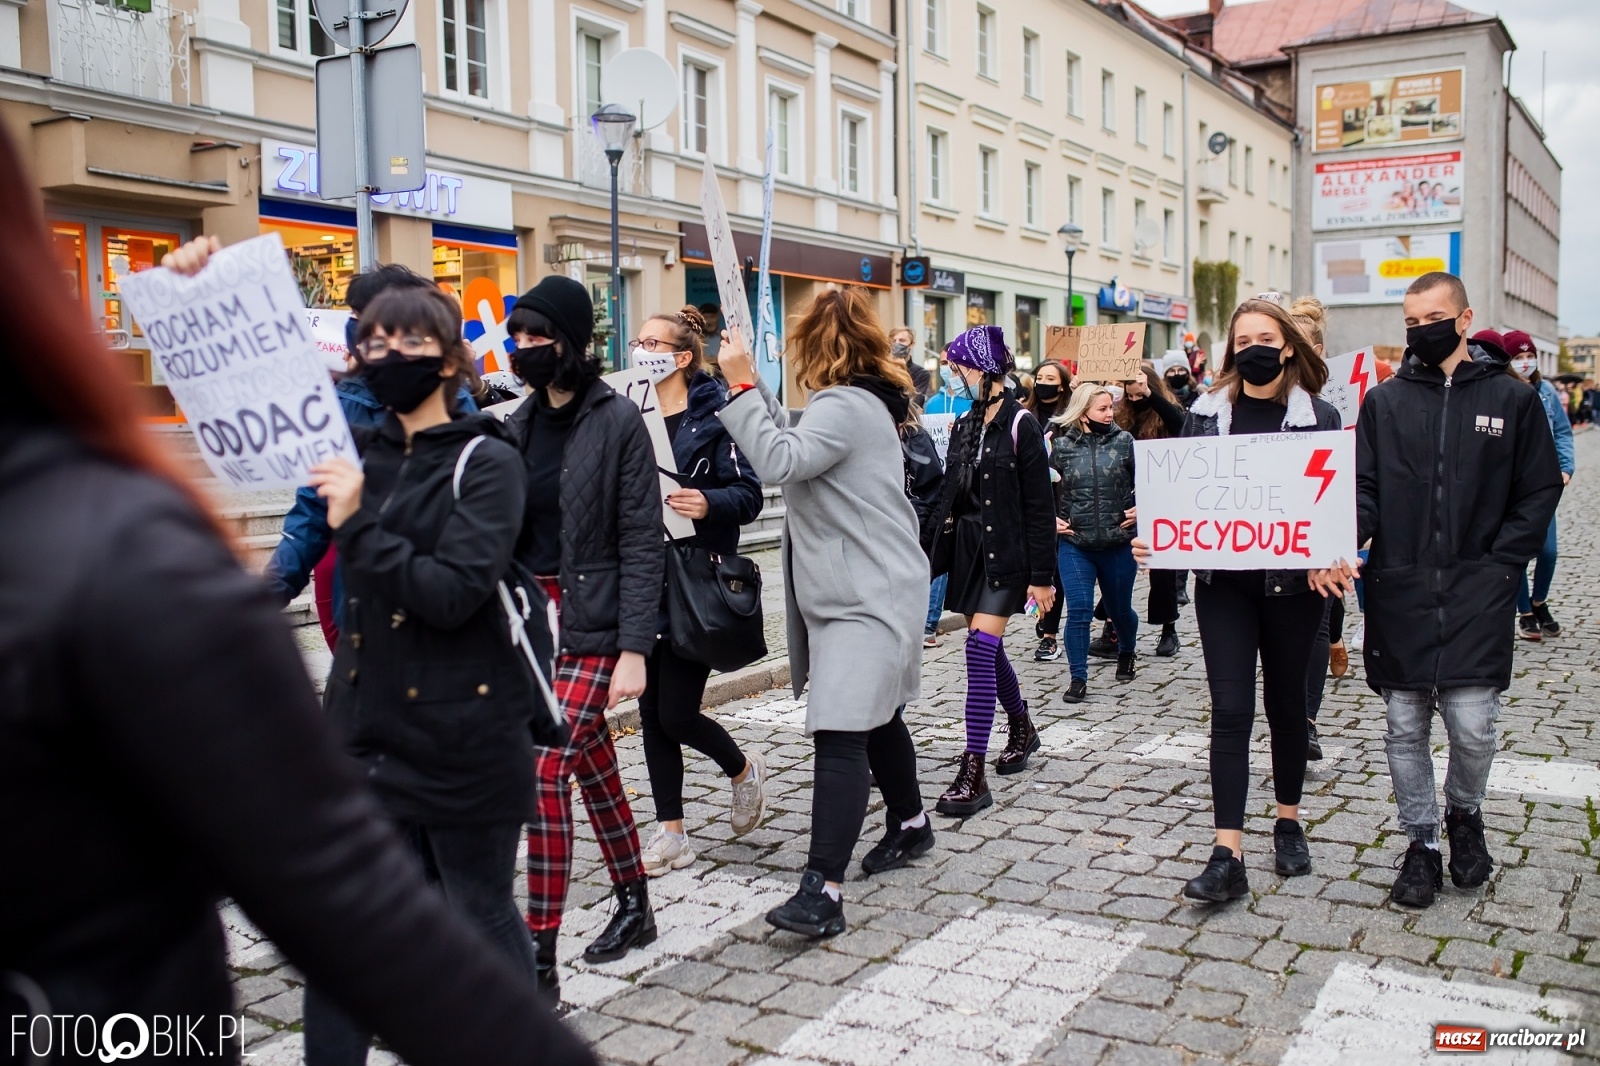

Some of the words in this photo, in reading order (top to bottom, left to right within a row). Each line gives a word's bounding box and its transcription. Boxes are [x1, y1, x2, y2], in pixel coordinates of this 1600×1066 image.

[1321, 185, 1367, 197] MEBLE
[1322, 165, 1455, 187] ALEXANDER
[142, 294, 250, 351] KOCHAM
[262, 284, 278, 313] I
[160, 312, 307, 382] ROZUMIEM
[221, 458, 263, 485] NIE
[1147, 442, 1250, 484] MYŚLĘ
[1195, 485, 1286, 513] CZUJĘ
[1153, 518, 1311, 558] DECYDUJĘ
